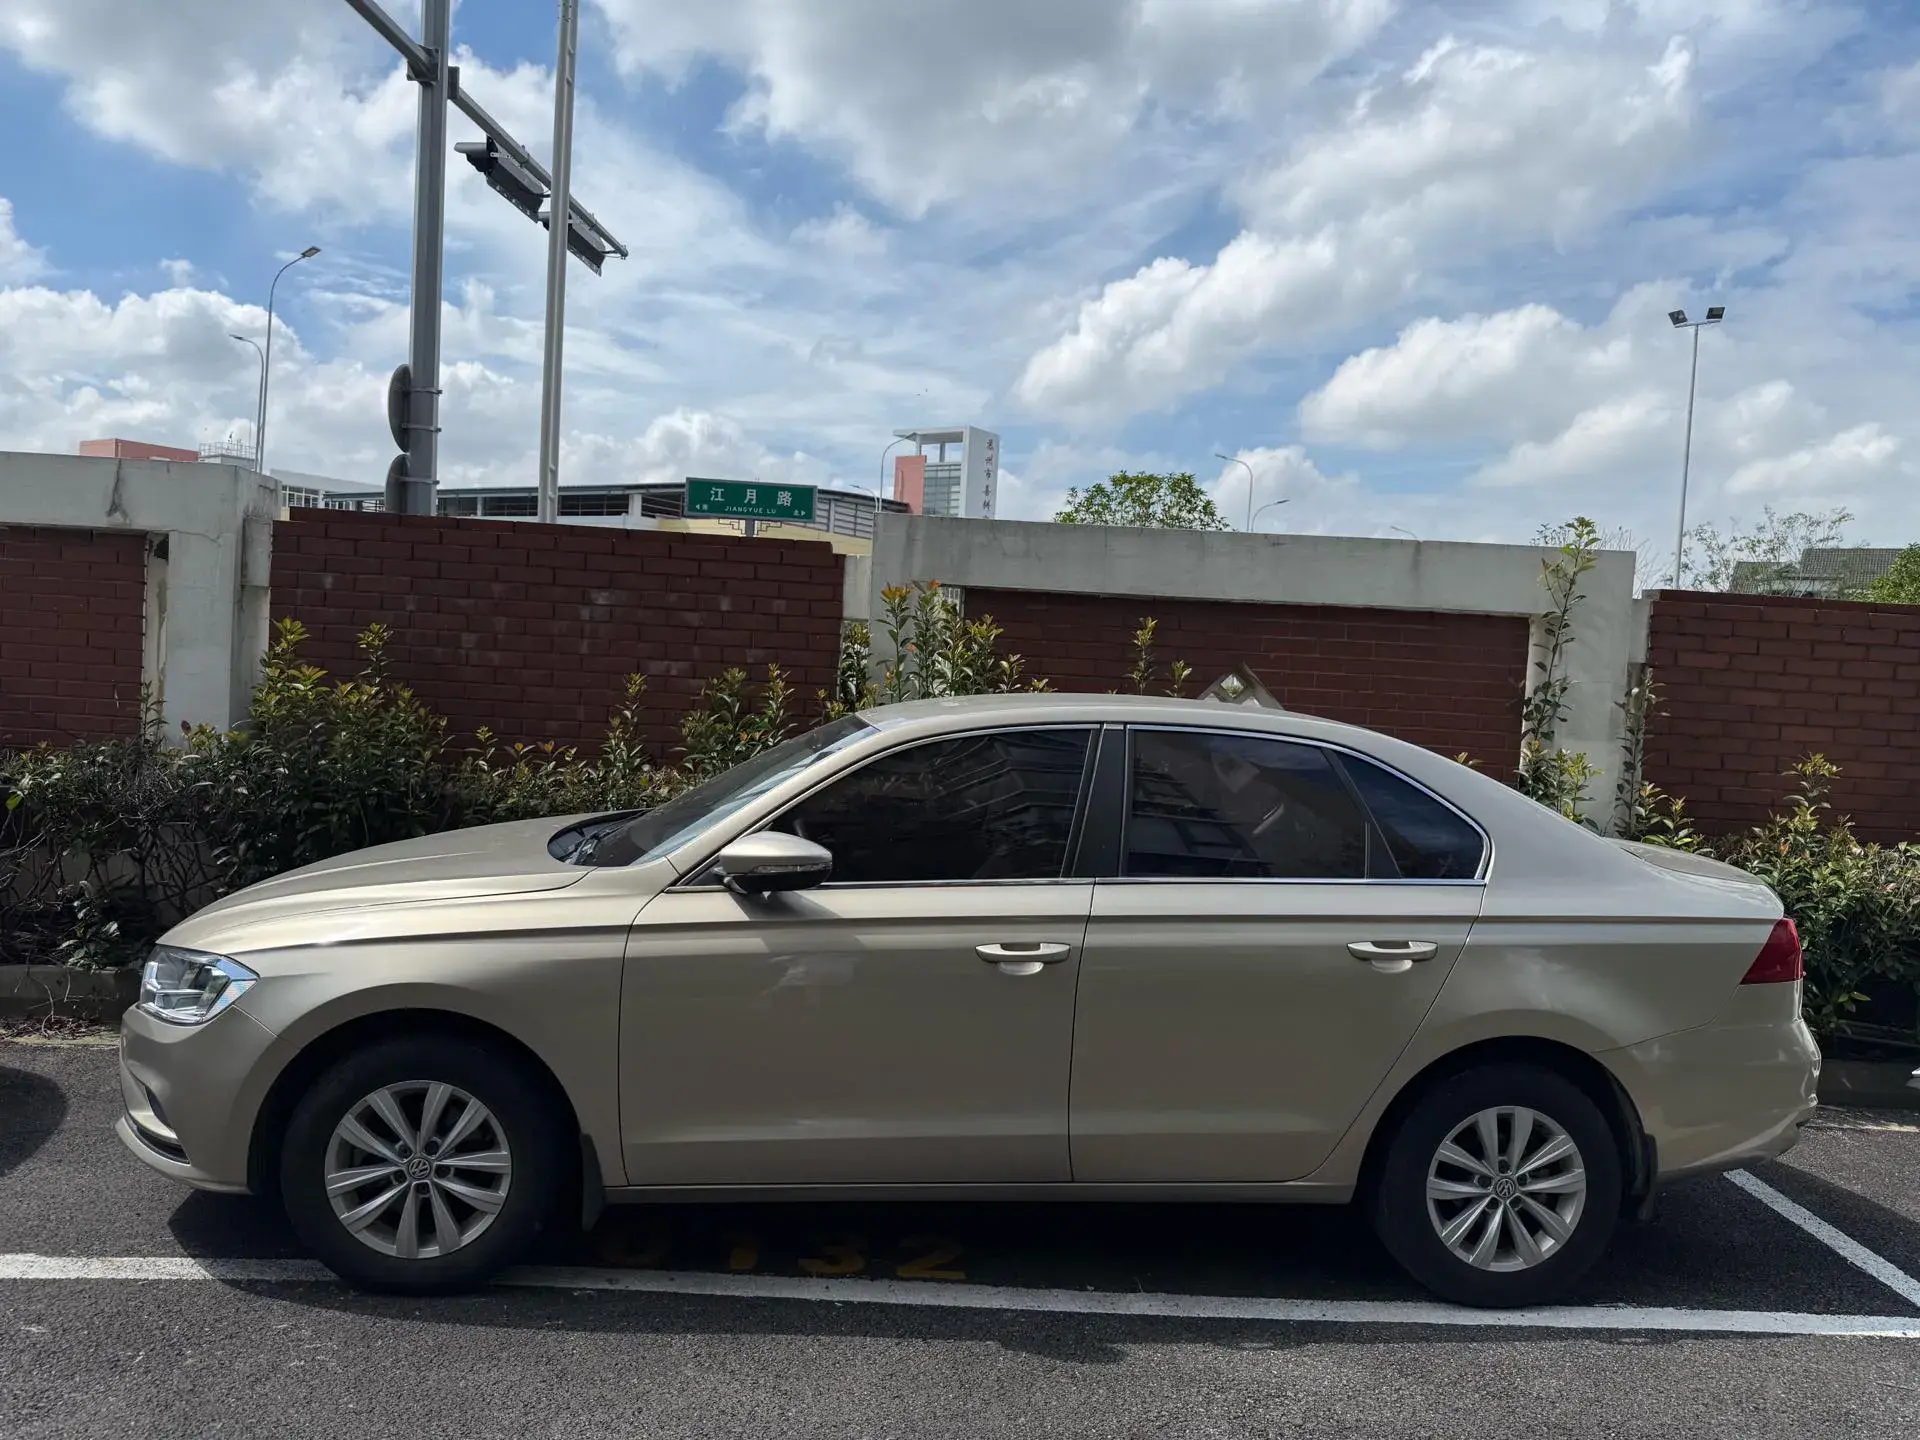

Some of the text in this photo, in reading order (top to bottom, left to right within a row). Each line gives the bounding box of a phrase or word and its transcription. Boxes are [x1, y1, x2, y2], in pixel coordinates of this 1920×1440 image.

[710, 487, 793, 507] 江月路
[724, 505, 763, 514] JIANGYUE
